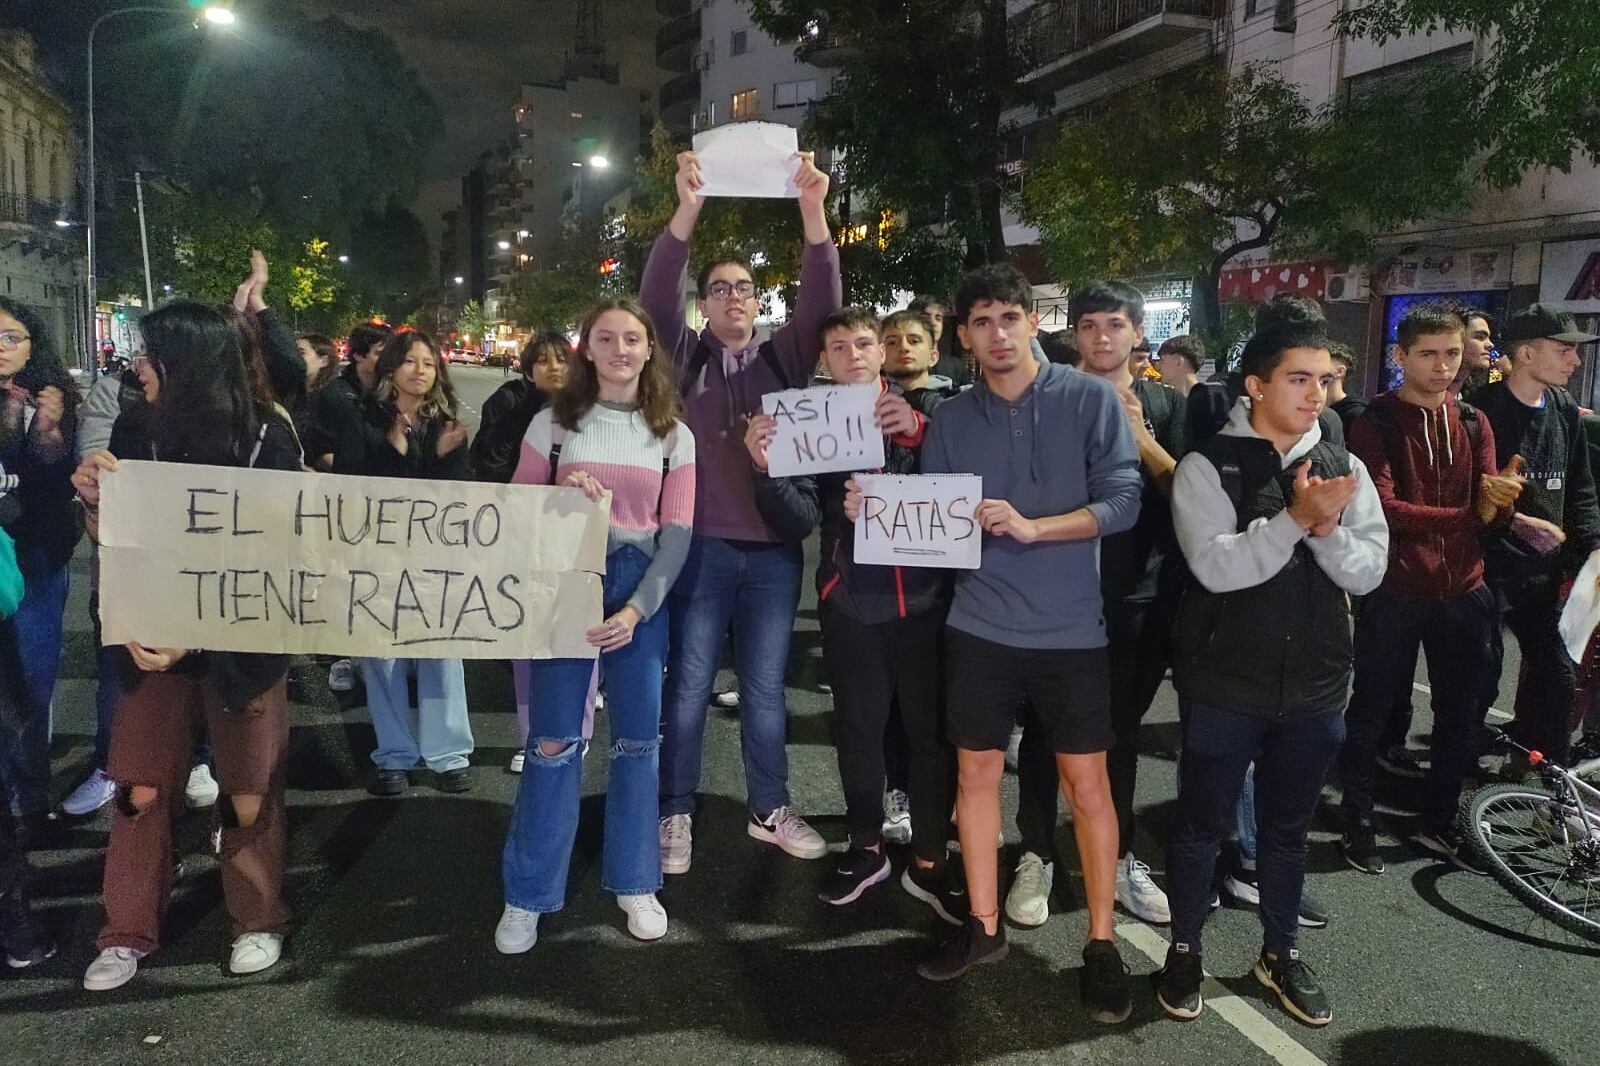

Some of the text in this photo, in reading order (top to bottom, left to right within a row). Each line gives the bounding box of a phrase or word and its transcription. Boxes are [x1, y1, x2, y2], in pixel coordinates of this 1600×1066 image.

[773, 391, 831, 427] ASÍ
[793, 415, 864, 464] NO!!
[185, 488, 501, 547] EL HUERGO
[864, 496, 974, 541] RATAS
[179, 568, 525, 638] TIENE RATAS
